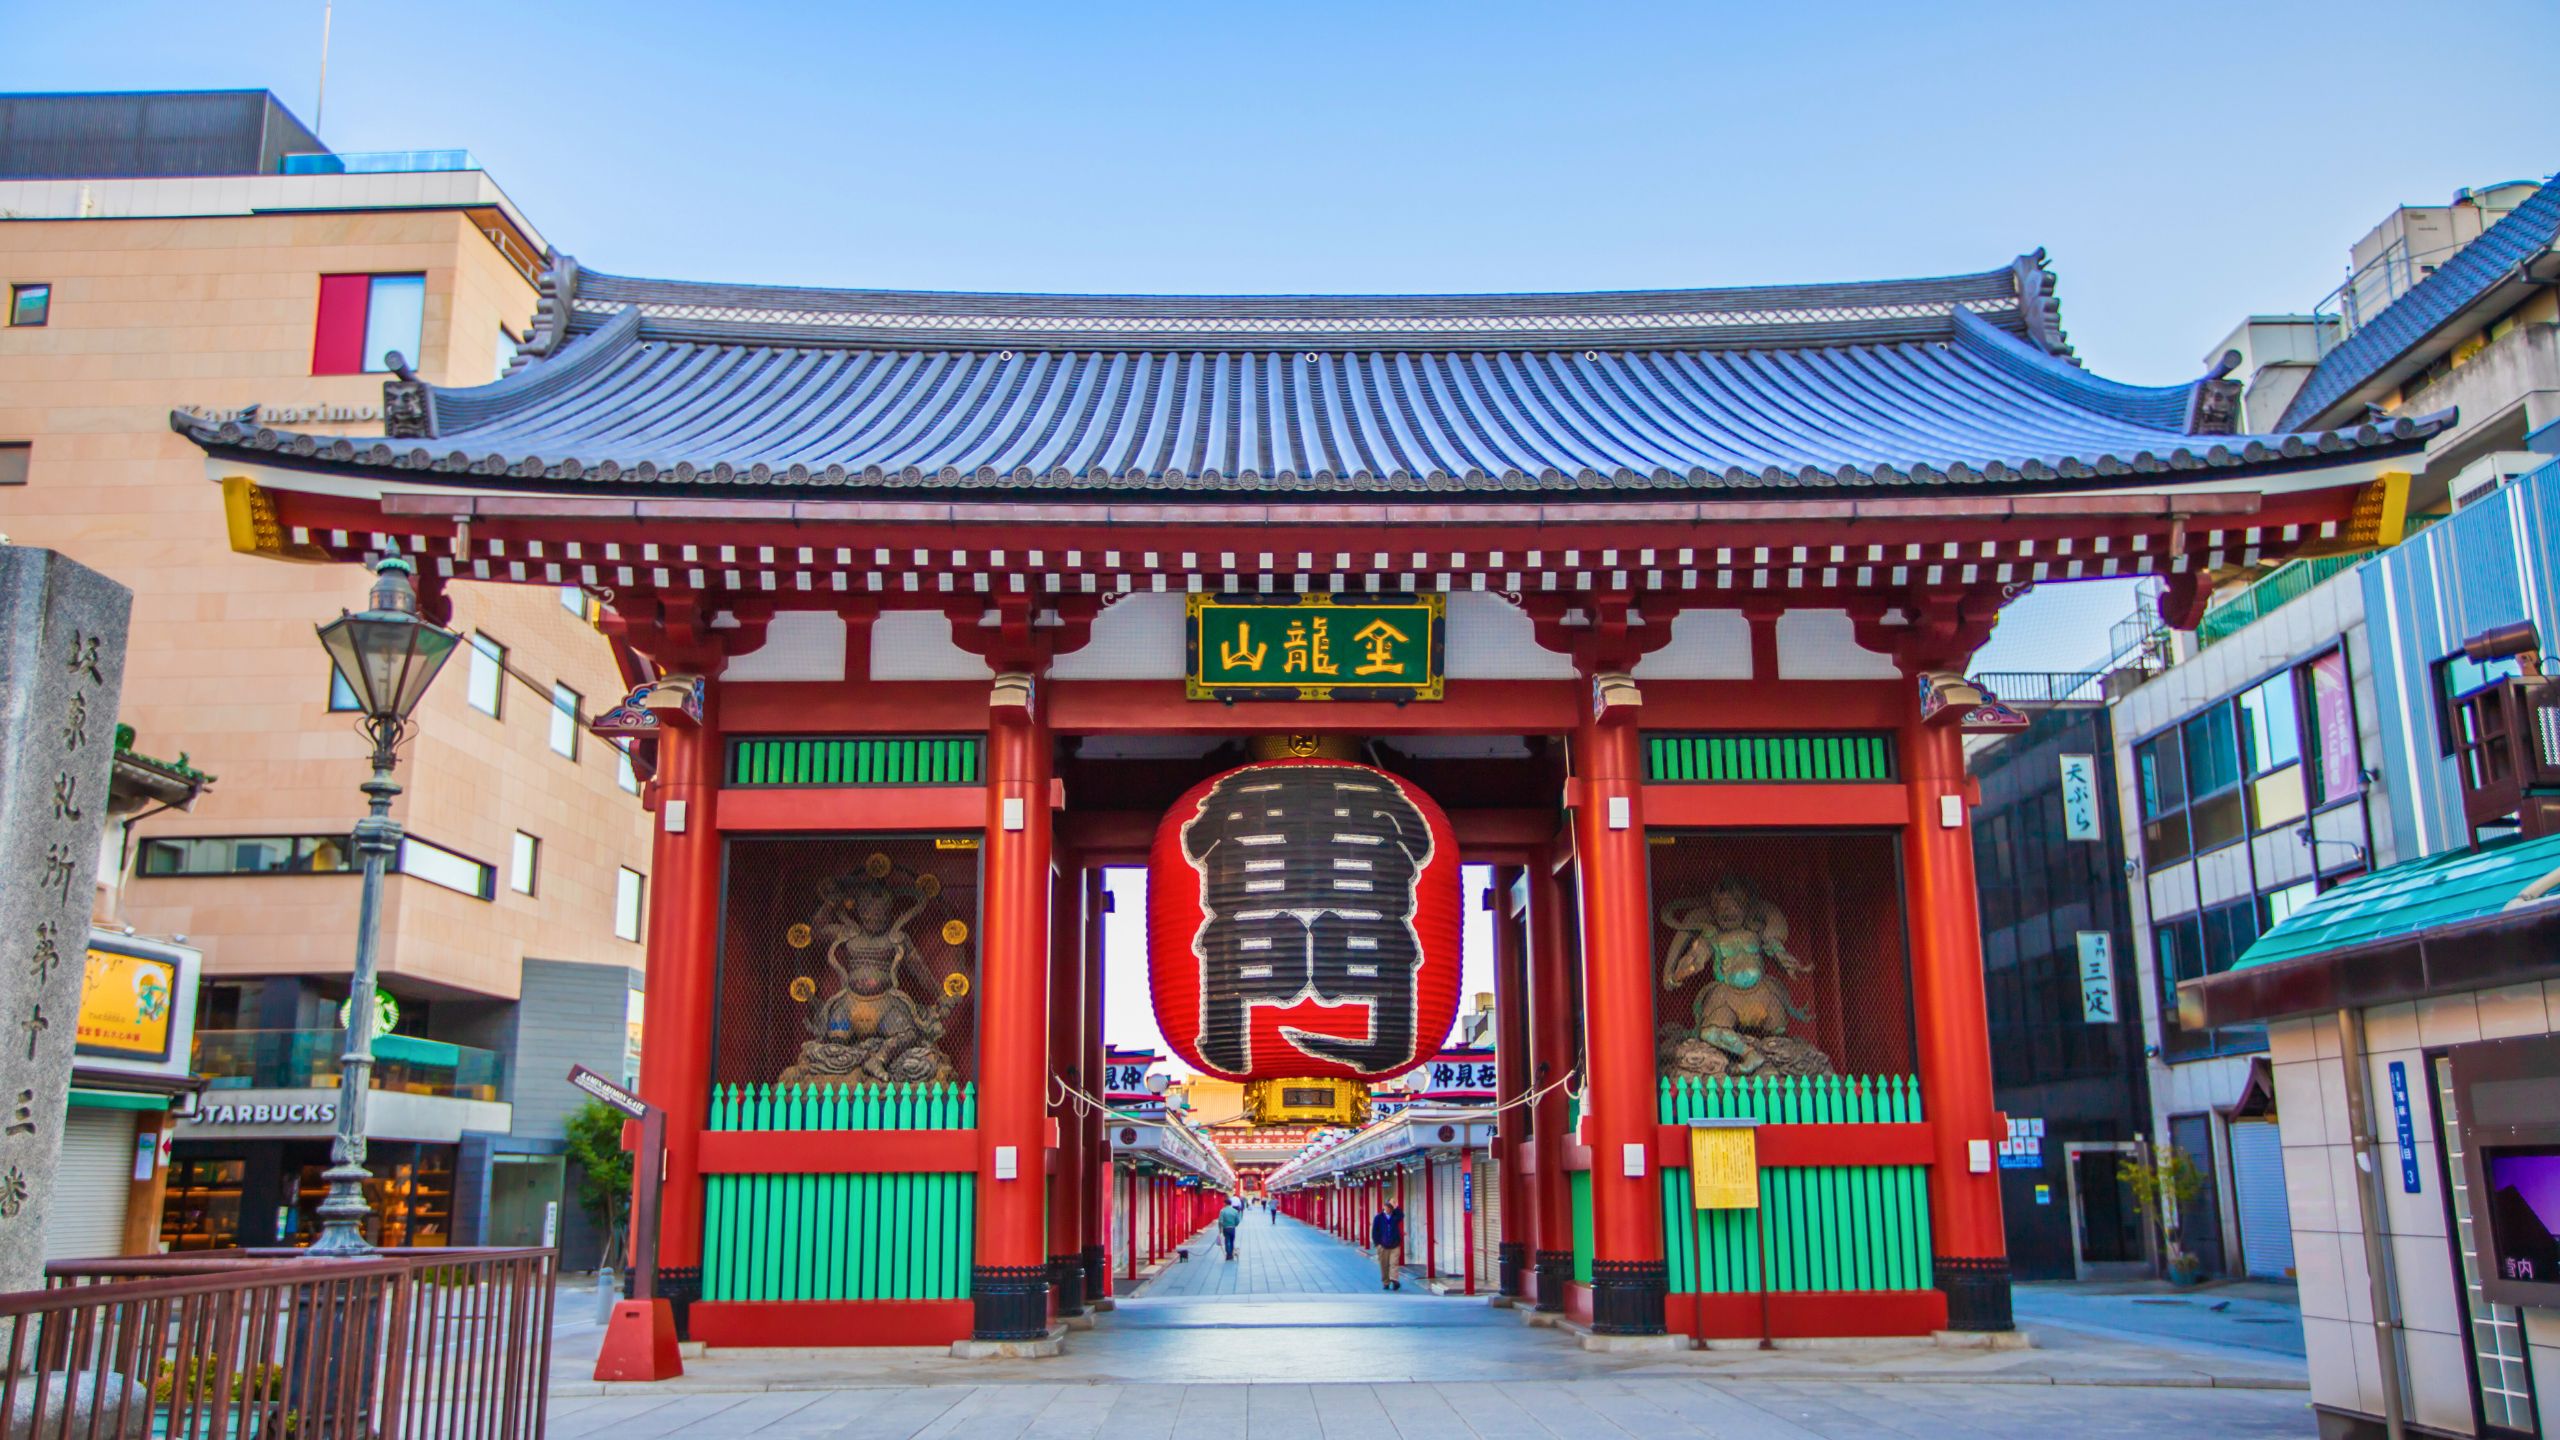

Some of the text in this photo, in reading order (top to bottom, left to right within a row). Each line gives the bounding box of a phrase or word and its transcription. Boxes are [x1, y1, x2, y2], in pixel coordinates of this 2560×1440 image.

[178, 402, 385, 425] amnarimo
[1181, 765, 1435, 1074] 雷門
[2406, 1169, 2415, 1185] 3
